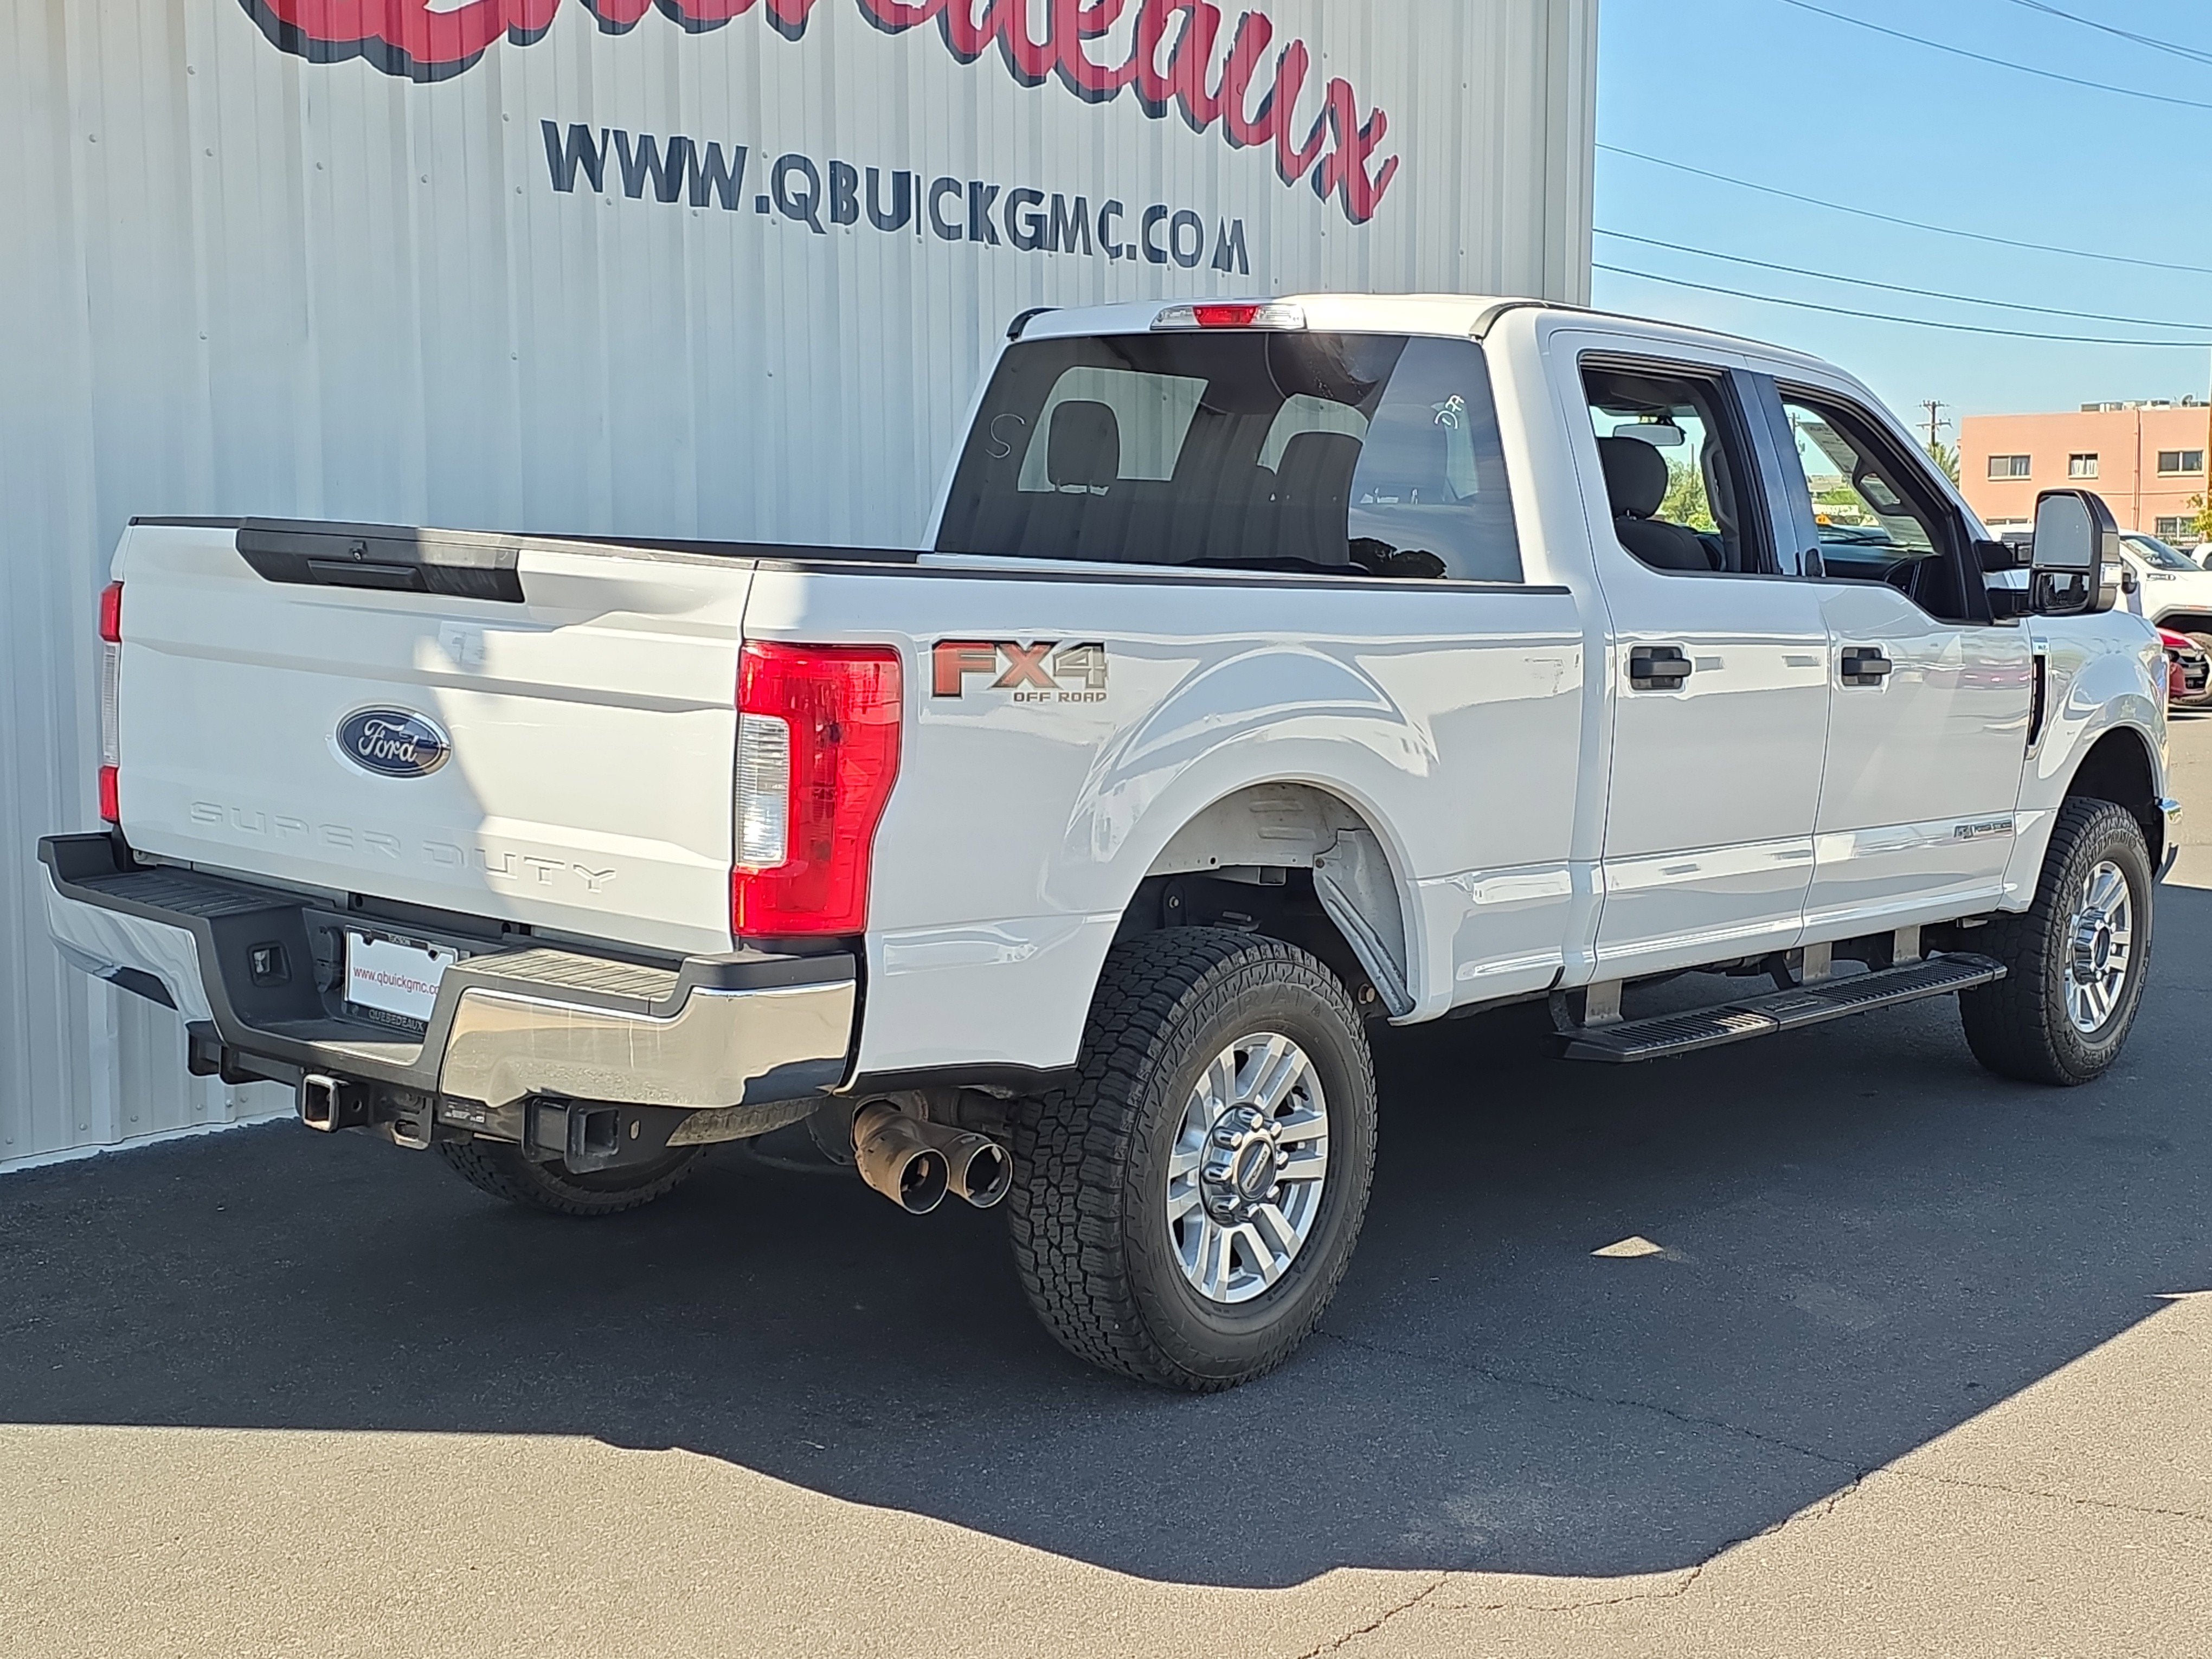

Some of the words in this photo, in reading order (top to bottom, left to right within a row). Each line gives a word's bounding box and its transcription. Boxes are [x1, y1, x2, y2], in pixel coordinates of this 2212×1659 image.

[541, 119, 1250, 275] WWW.QBUICKGMC.COM
[932, 639, 1108, 698] FX4
[1013, 692, 1051, 702] OFF
[1058, 692, 1107, 703] ROAD
[358, 719, 420, 762] Ford
[191, 801, 402, 859] SUPER
[422, 840, 617, 893] DUTY
[353, 967, 440, 995] www.qbuickgmc.co
